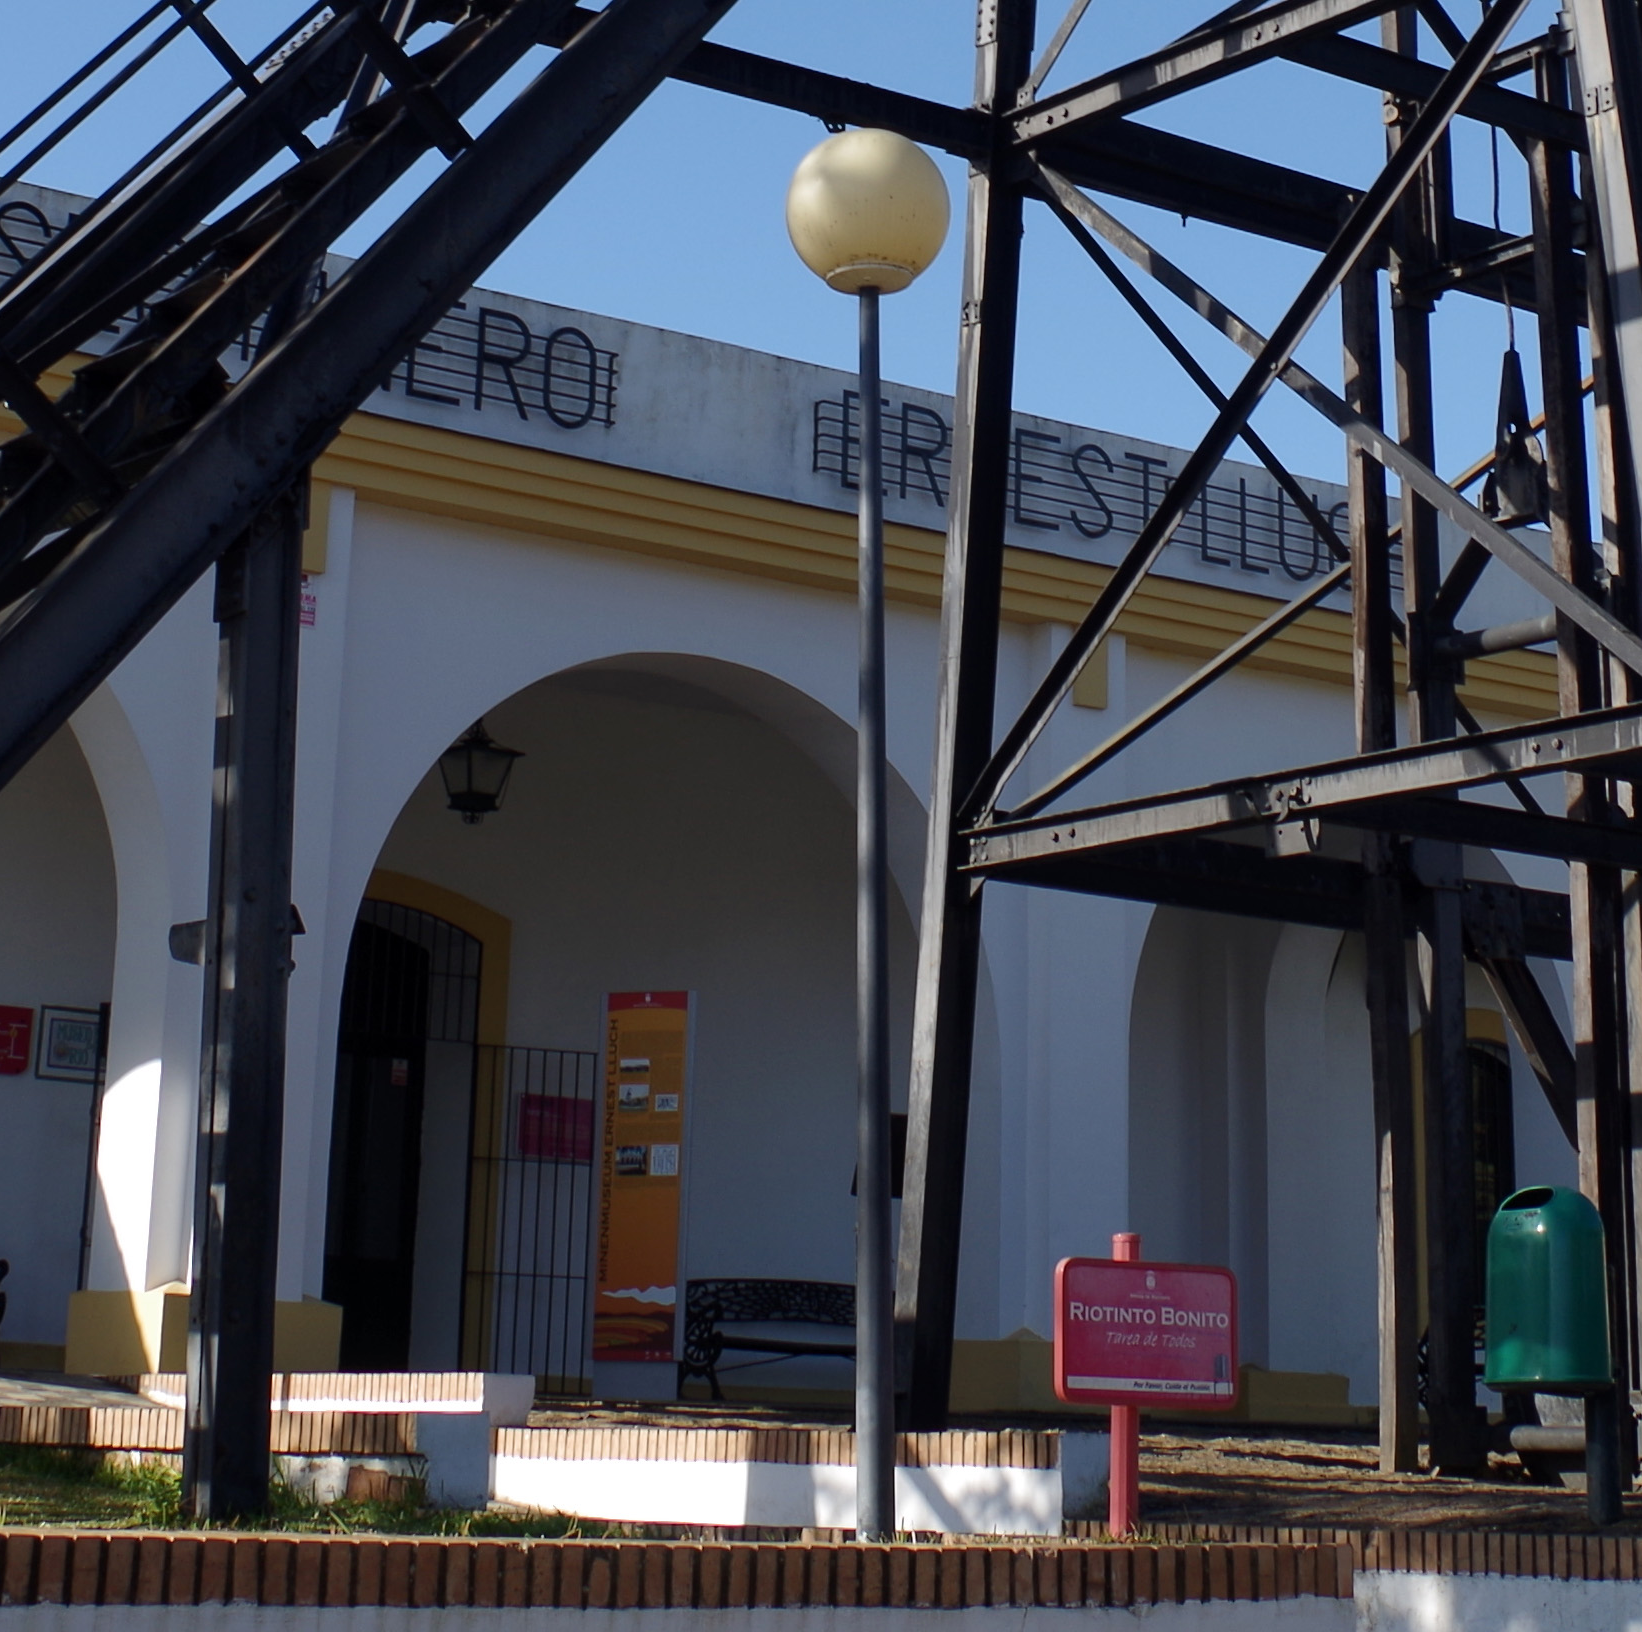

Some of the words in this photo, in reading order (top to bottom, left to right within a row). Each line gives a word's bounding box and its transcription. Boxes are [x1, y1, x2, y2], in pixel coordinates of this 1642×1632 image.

[609, 1019, 620, 1076] LLUCH
[605, 1081, 617, 1146] ERNEST
[1106, 1331, 1139, 1346] Tarea
[1143, 1332, 1157, 1347] de
[1162, 1334, 1196, 1348] Todos
